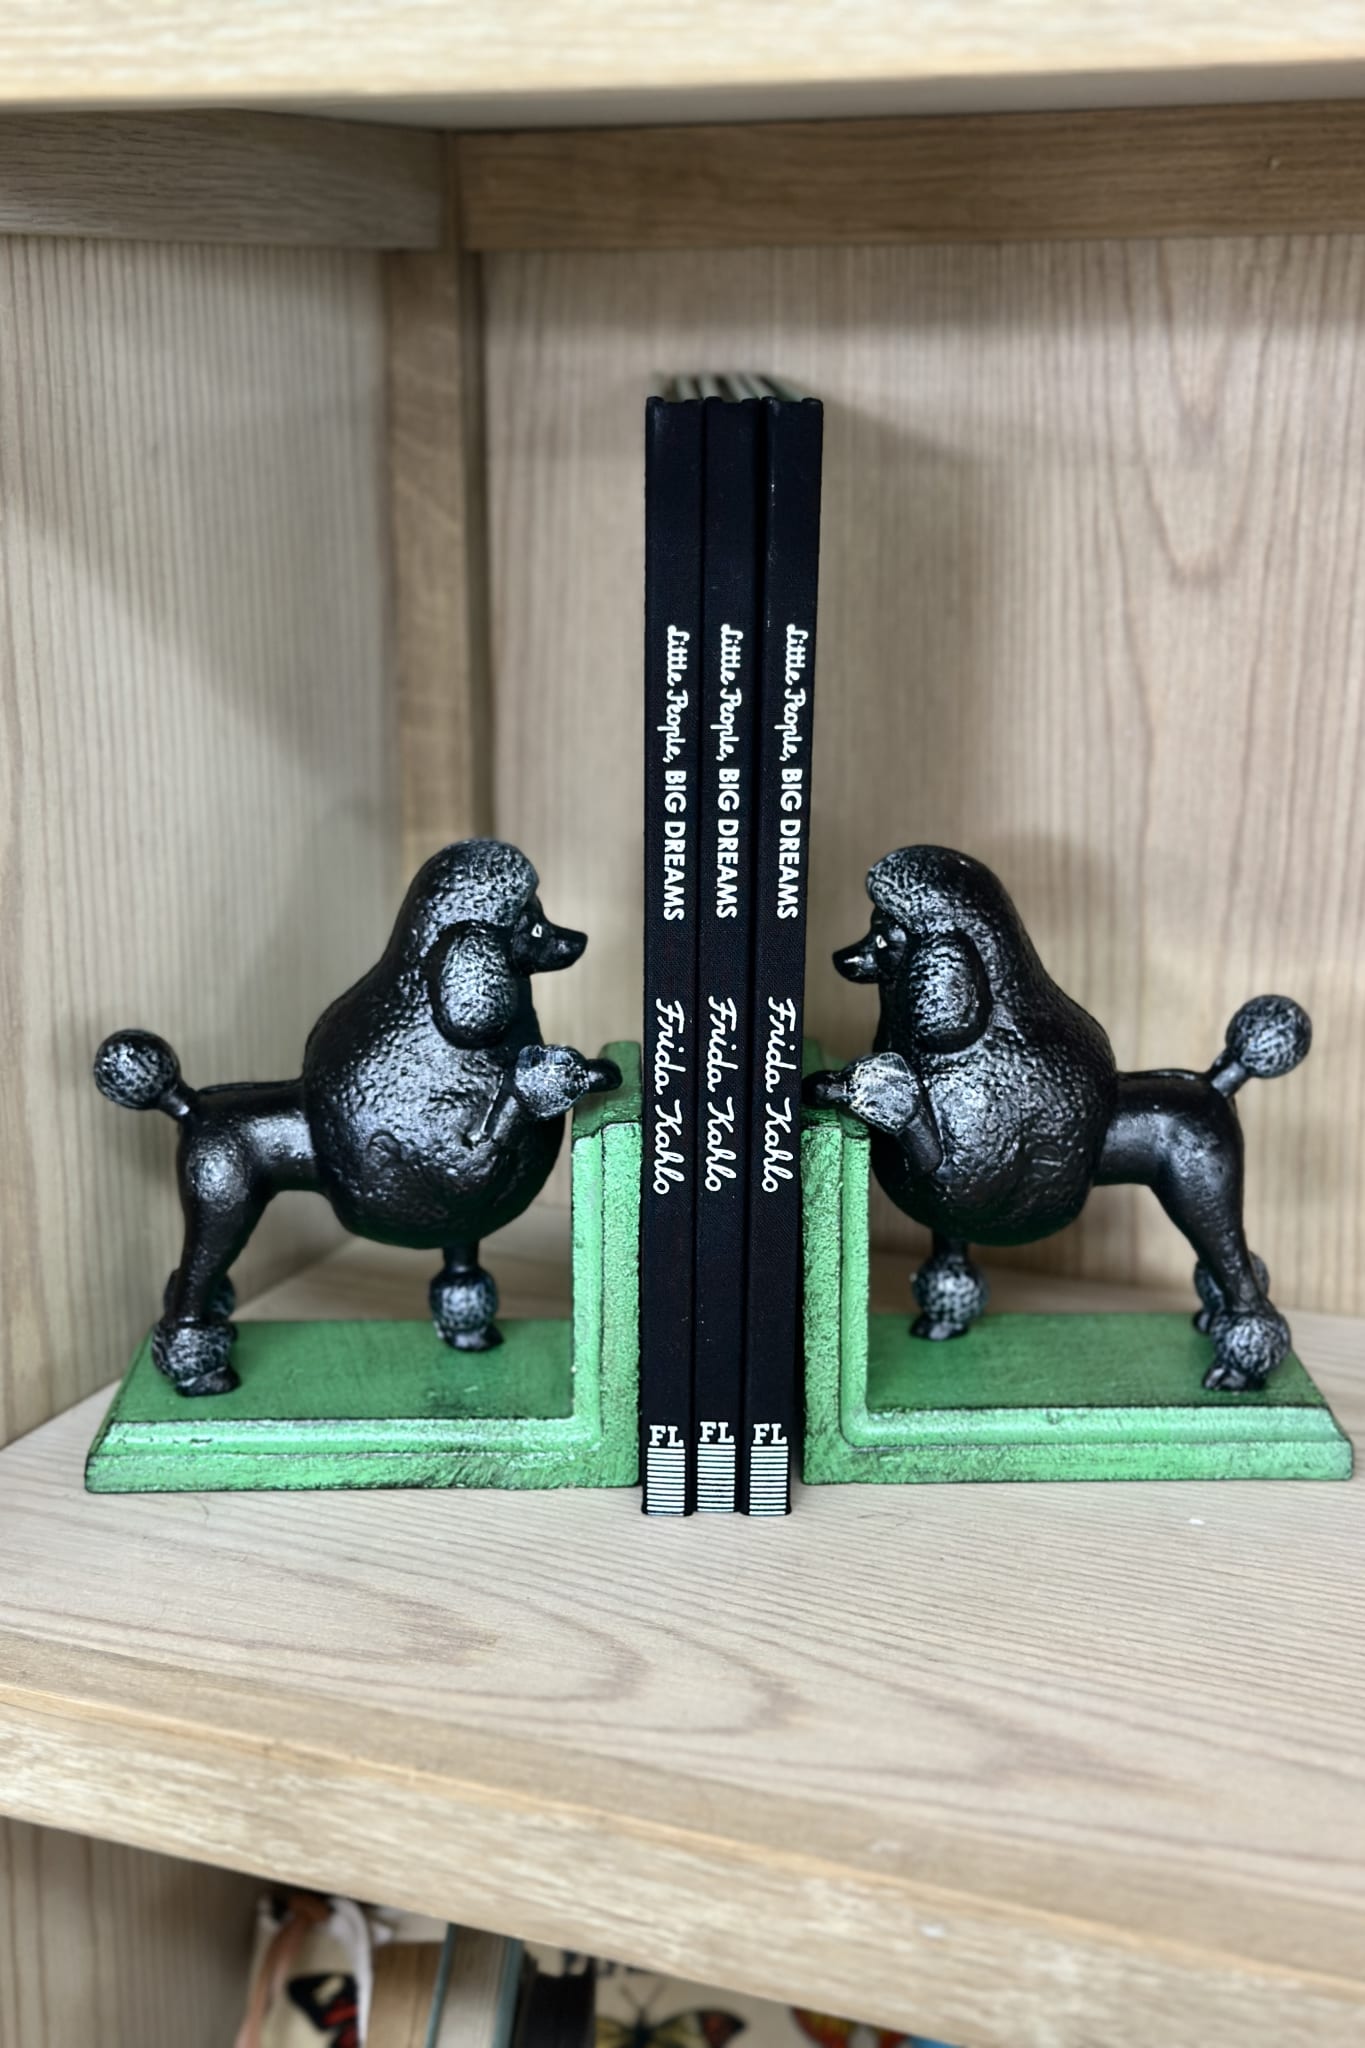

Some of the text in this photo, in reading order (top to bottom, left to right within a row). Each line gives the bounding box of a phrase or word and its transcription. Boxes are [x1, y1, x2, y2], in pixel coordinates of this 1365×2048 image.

[657, 625, 690, 920] Little People, BIG DREAMS
[710, 624, 743, 918] Little People, BIG DREAMS
[774, 624, 808, 919] Little People, BIG DREAMS
[653, 998, 686, 1194] Frida Kahlo
[705, 996, 738, 1191] Frida Kahlo
[762, 997, 796, 1192] Frida Kahlo
[649, 1425, 684, 1447] FL
[700, 1422, 734, 1443] FL
[753, 1423, 787, 1444] FL
